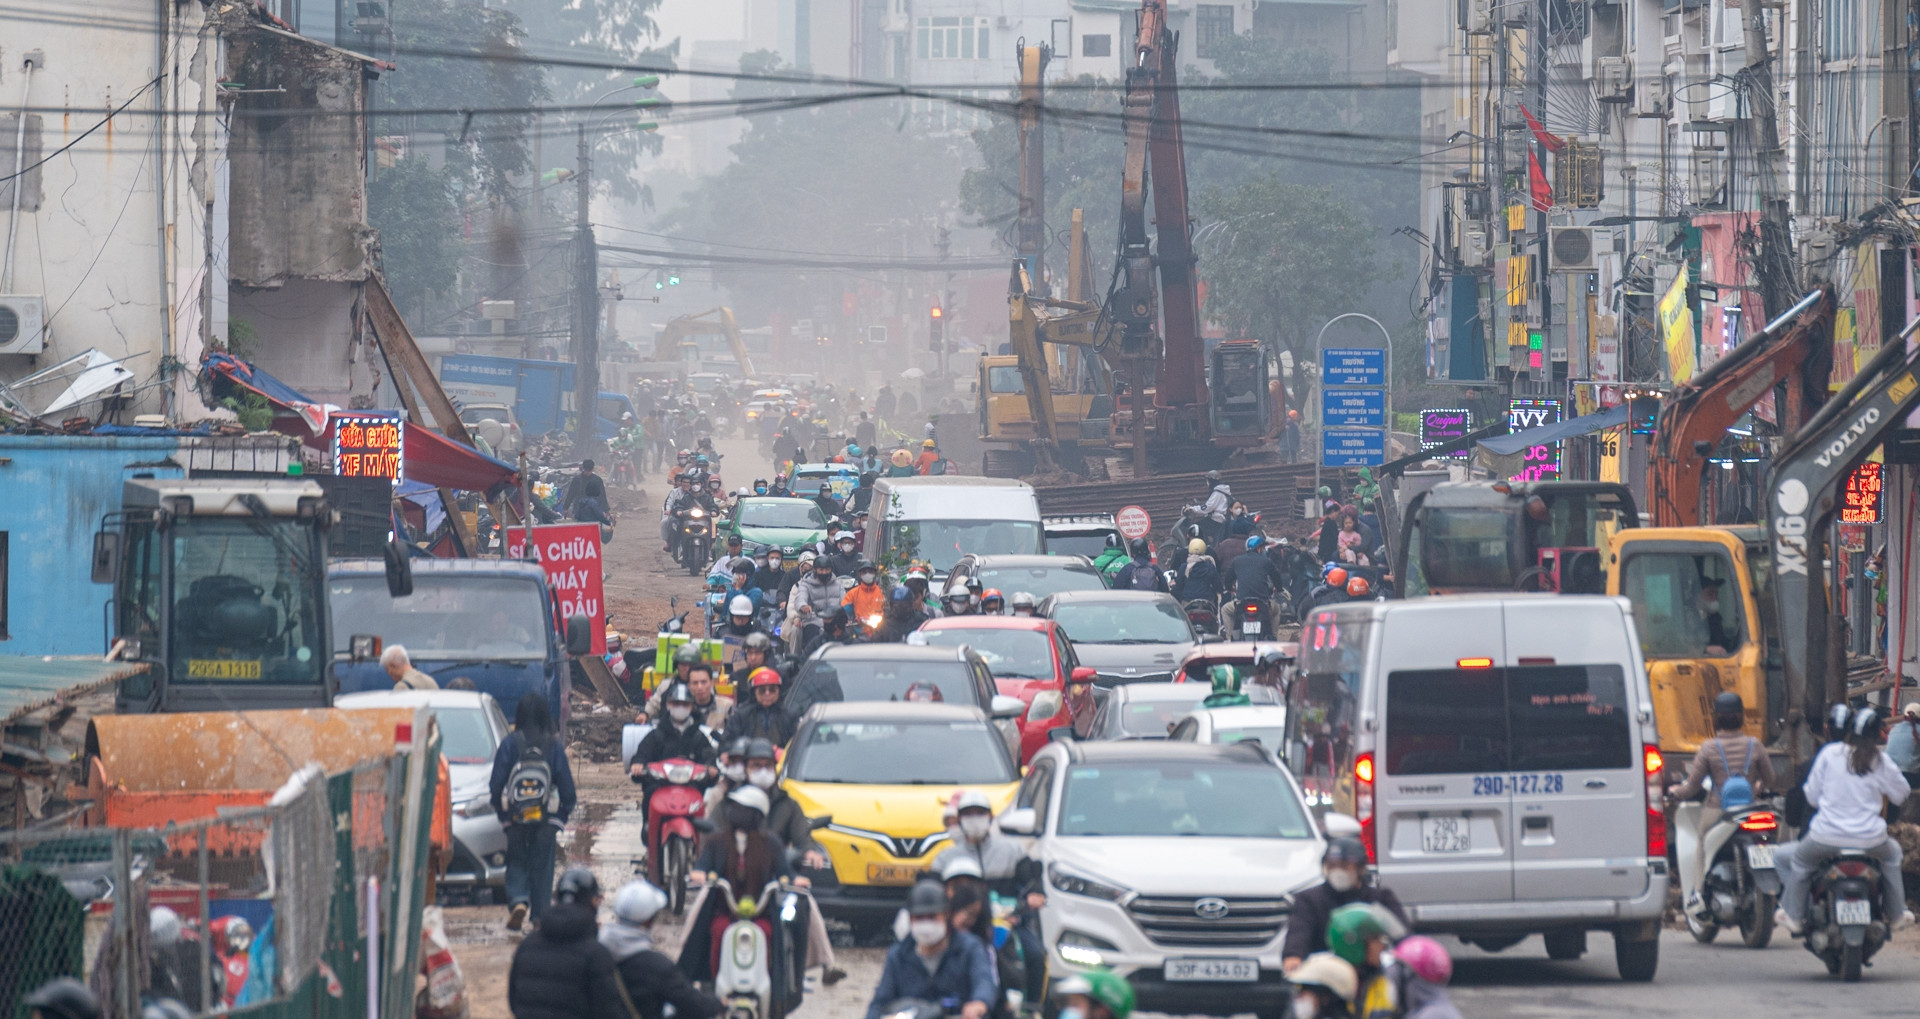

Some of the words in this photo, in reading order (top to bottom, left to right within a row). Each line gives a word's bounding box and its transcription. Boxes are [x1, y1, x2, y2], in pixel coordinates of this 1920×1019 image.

[1426, 413, 1463, 429] Quỳnh
[1510, 409, 1549, 428] IVY
[340, 421, 365, 448] SỬA
[366, 423, 399, 448] CHỮA
[1814, 406, 1880, 468] VOLVO
[363, 447, 399, 480] MÁY
[547, 536, 597, 562] CHỮA
[551, 565, 588, 590] MÁY
[1473, 774, 1564, 796] 29D-127.28
[1432, 819, 1459, 835] 29D
